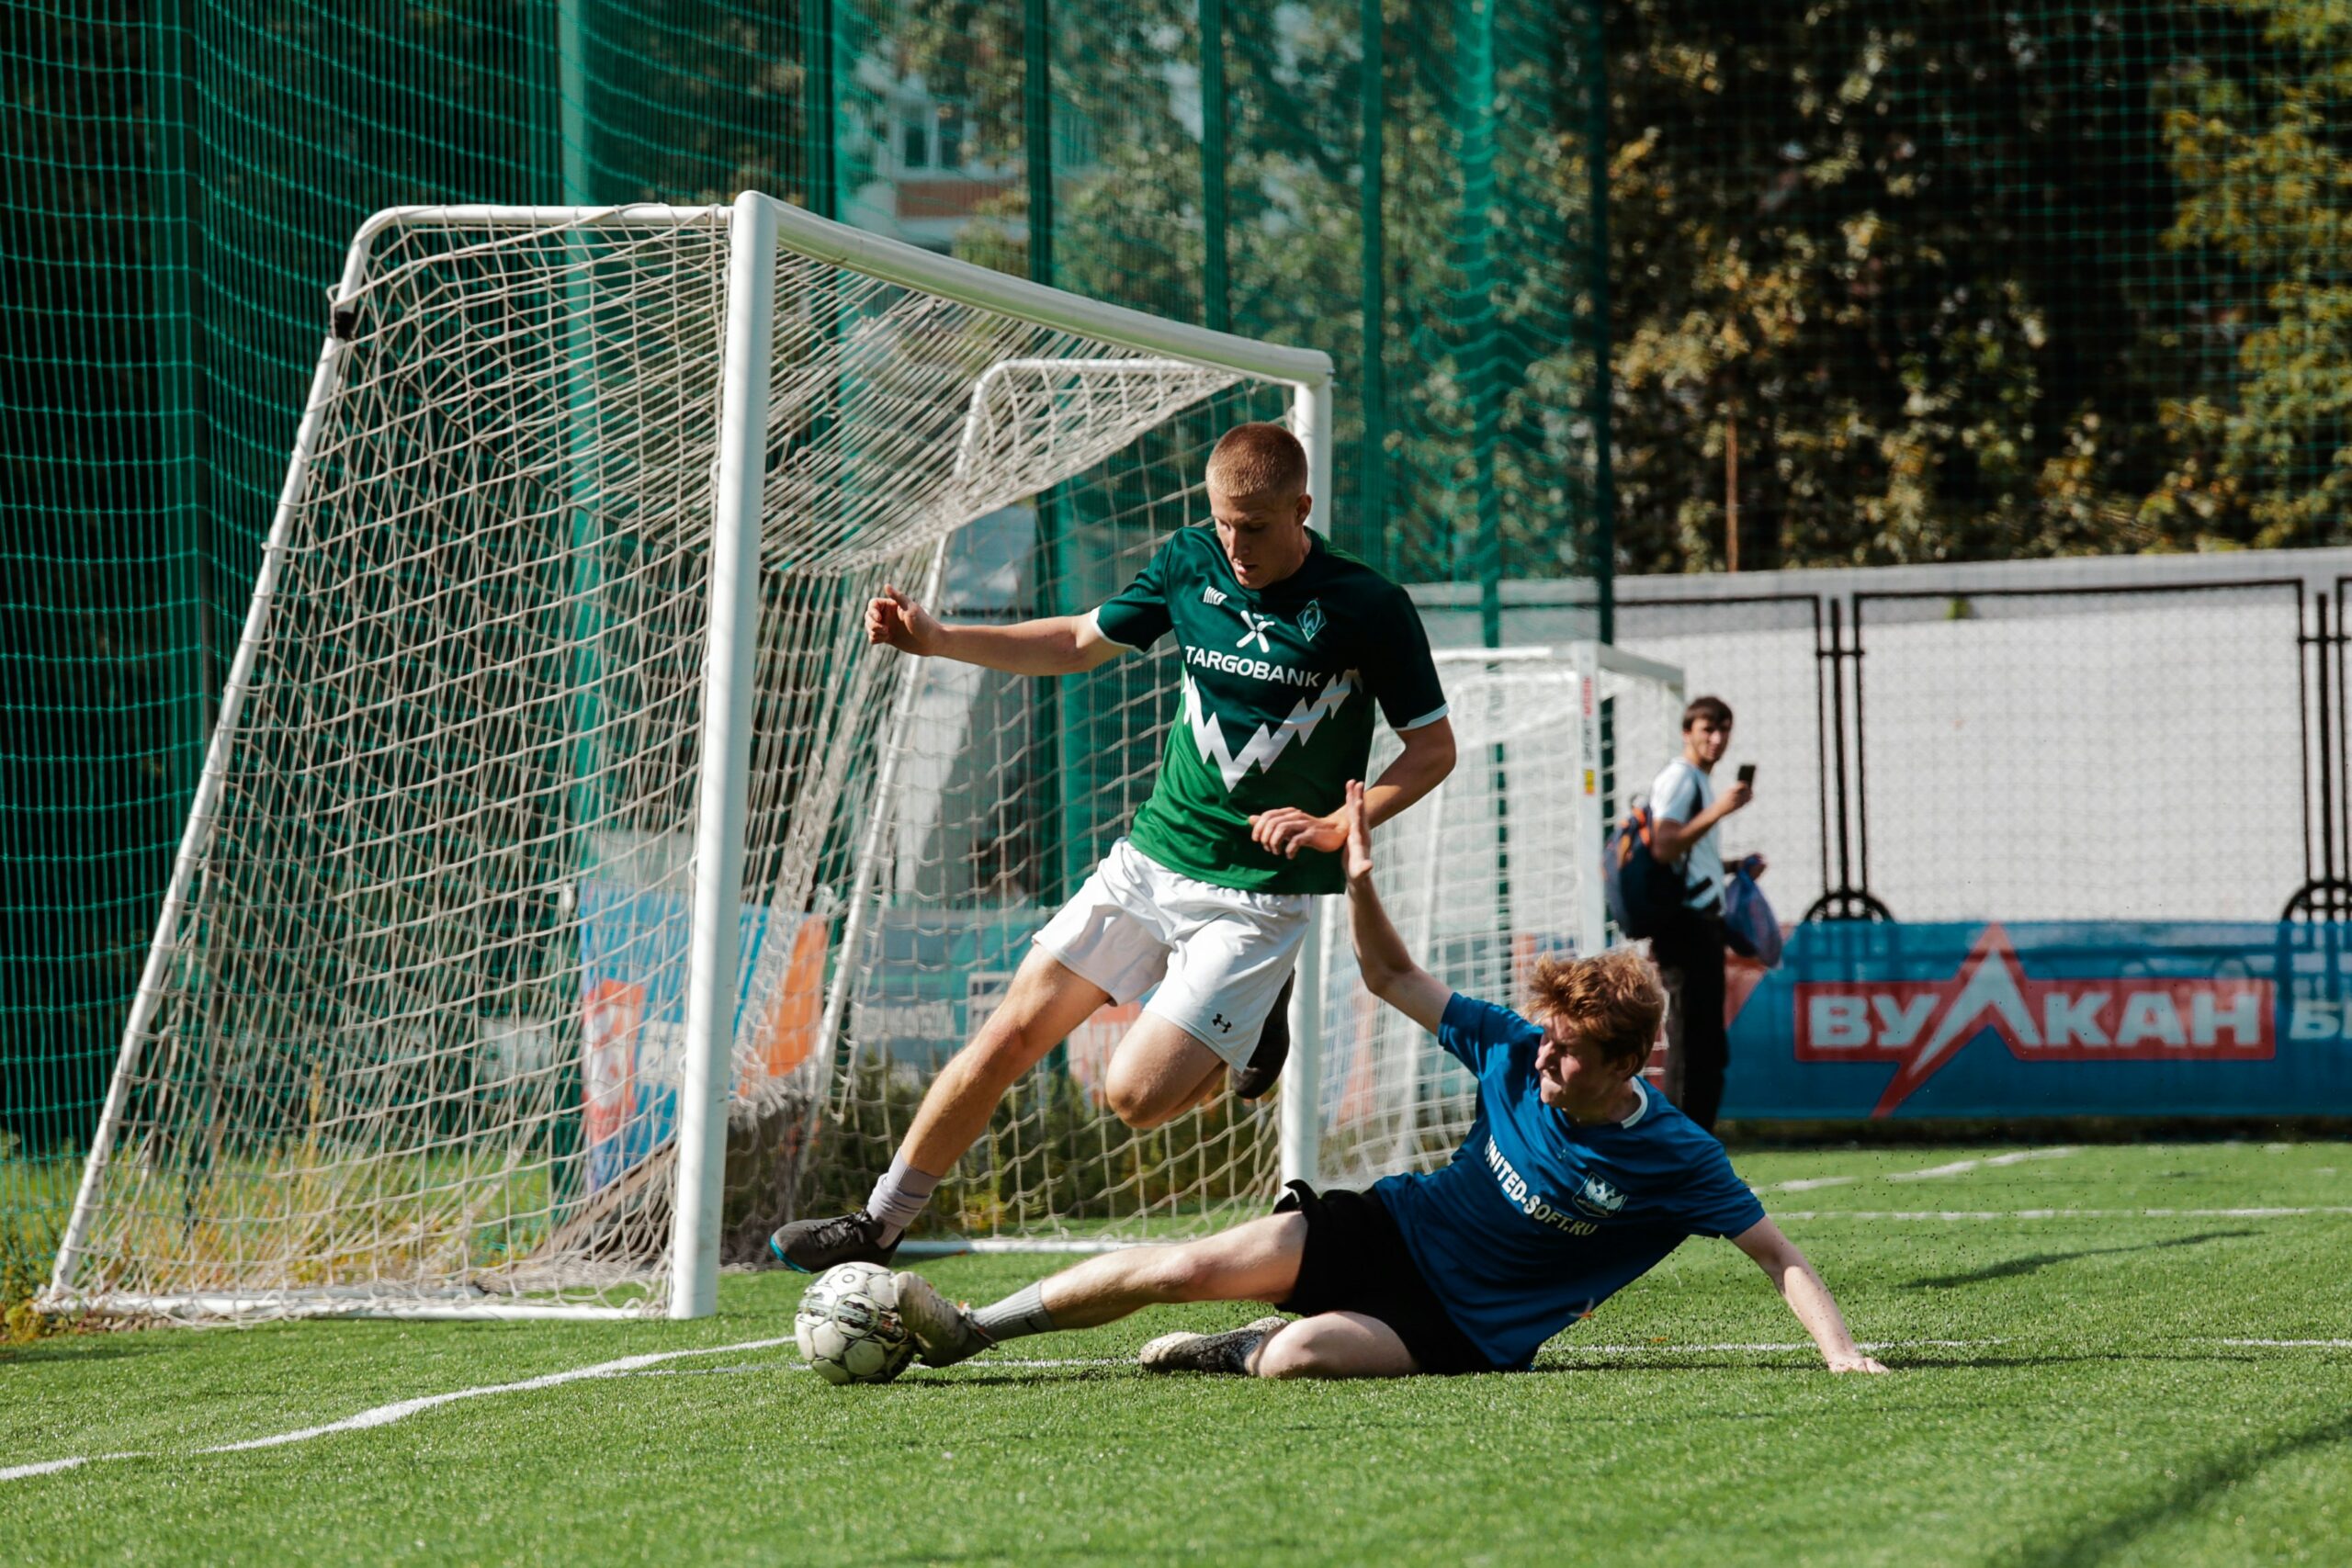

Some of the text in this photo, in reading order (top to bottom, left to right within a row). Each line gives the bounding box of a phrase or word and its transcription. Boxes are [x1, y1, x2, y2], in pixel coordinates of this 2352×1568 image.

[1185, 645, 1322, 688] TARGOBANK
[1808, 948, 2352, 1077] ВУЛКАН Б
[1484, 1134, 1599, 1235] UNITED-SOFT.RU
